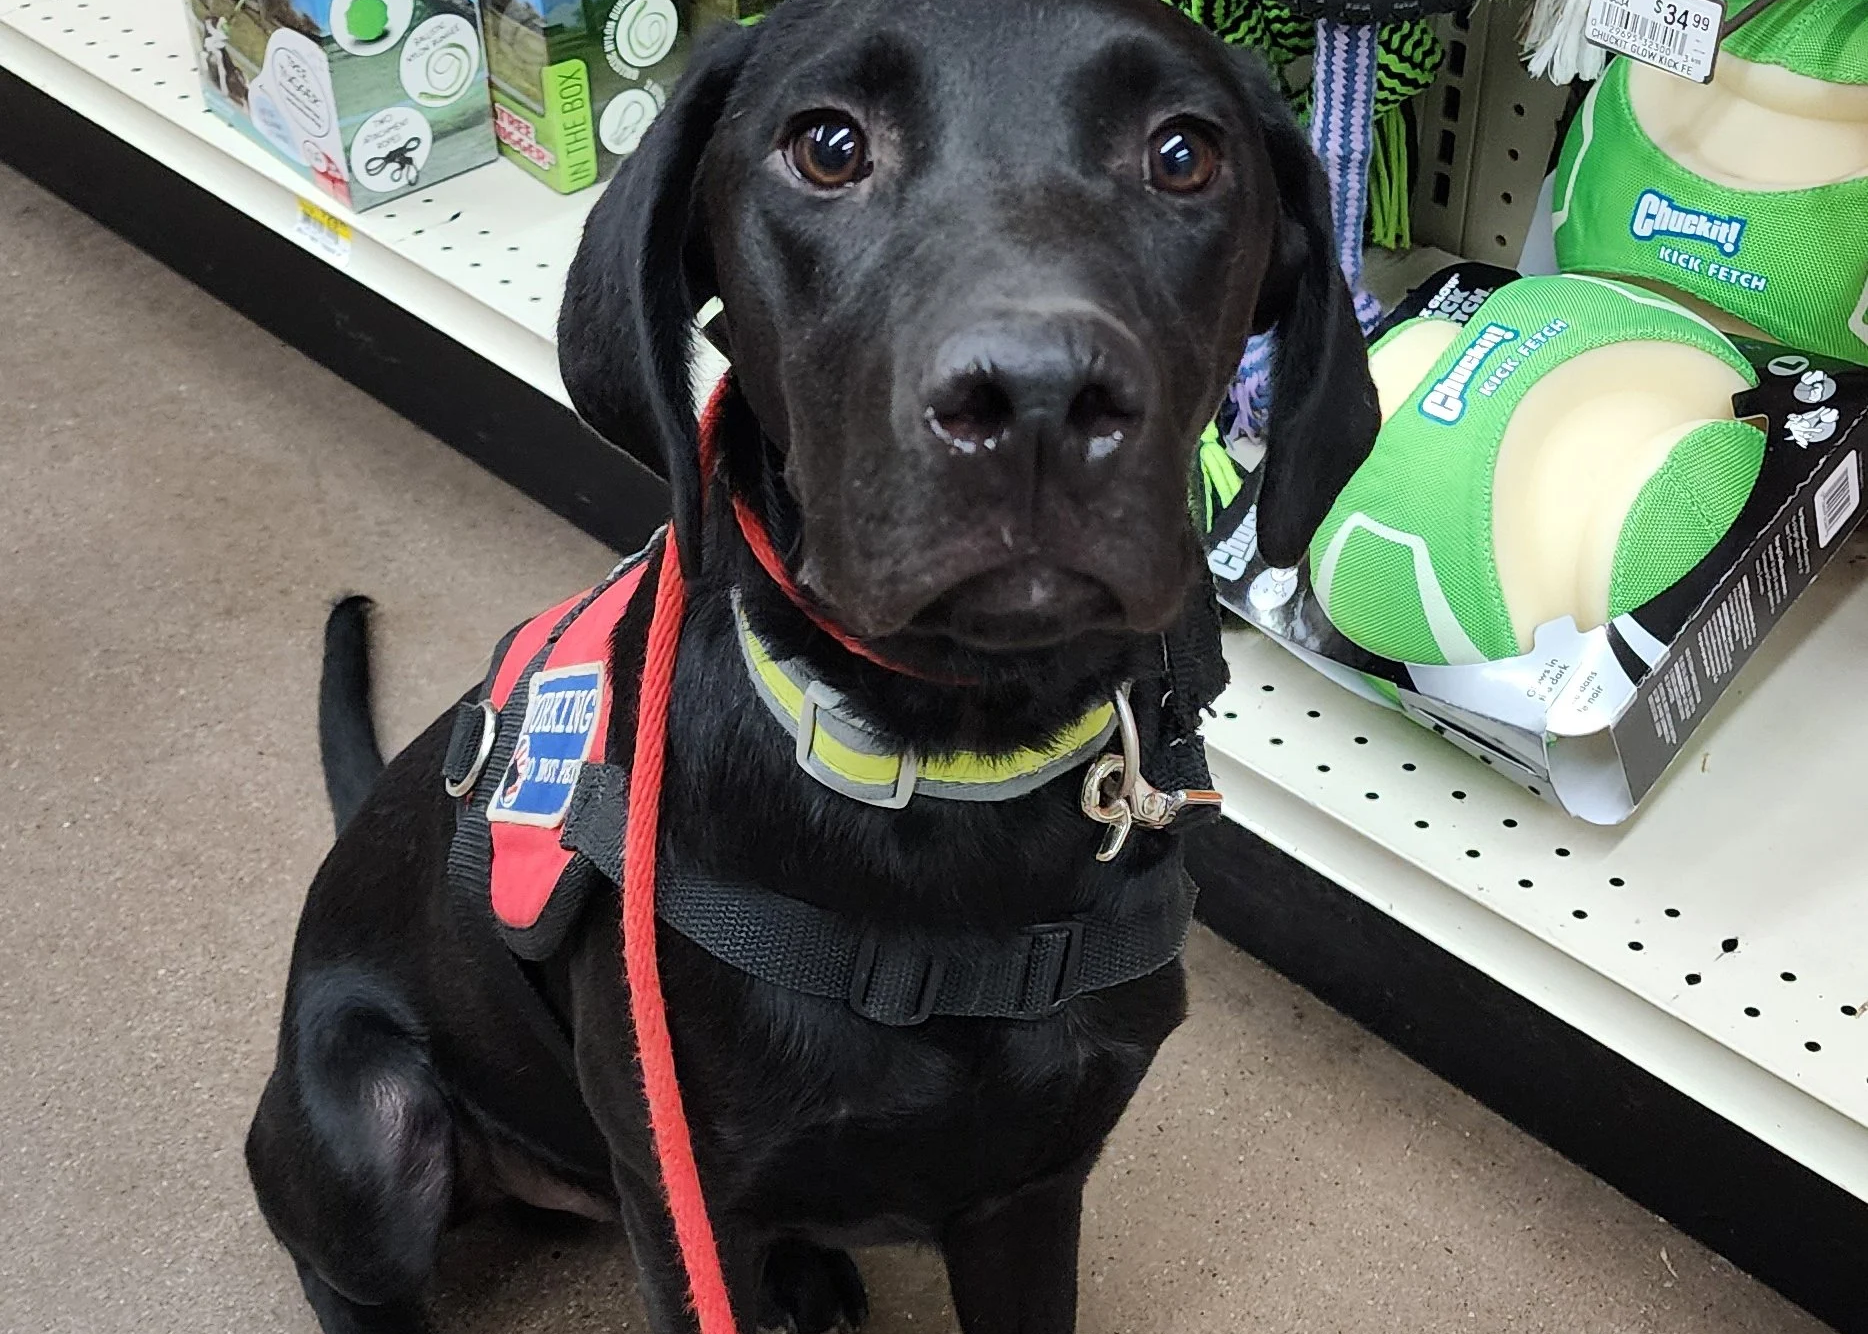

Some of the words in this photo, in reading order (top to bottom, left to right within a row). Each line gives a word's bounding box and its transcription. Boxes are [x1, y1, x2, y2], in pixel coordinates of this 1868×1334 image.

[1591, 27, 1629, 49] CHUCKIT
[1630, 43, 1657, 61] GLOW
[1658, 53, 1678, 71] KICK
[1680, 62, 1693, 76] FE
[1642, 37, 1671, 57] 32300
[556, 68, 585, 115] BOX
[562, 118, 589, 161] THE
[569, 165, 591, 183] IN
[1632, 192, 1742, 254] Chuckit!
[1658, 245, 1702, 273] KICK
[1707, 262, 1768, 291] FETCH
[1421, 324, 1516, 423] Chuckit!
[1477, 354, 1522, 398] KICK
[1516, 317, 1570, 359] FETCH
[1549, 663, 1570, 686] dark
[1587, 685, 1604, 705] noir
